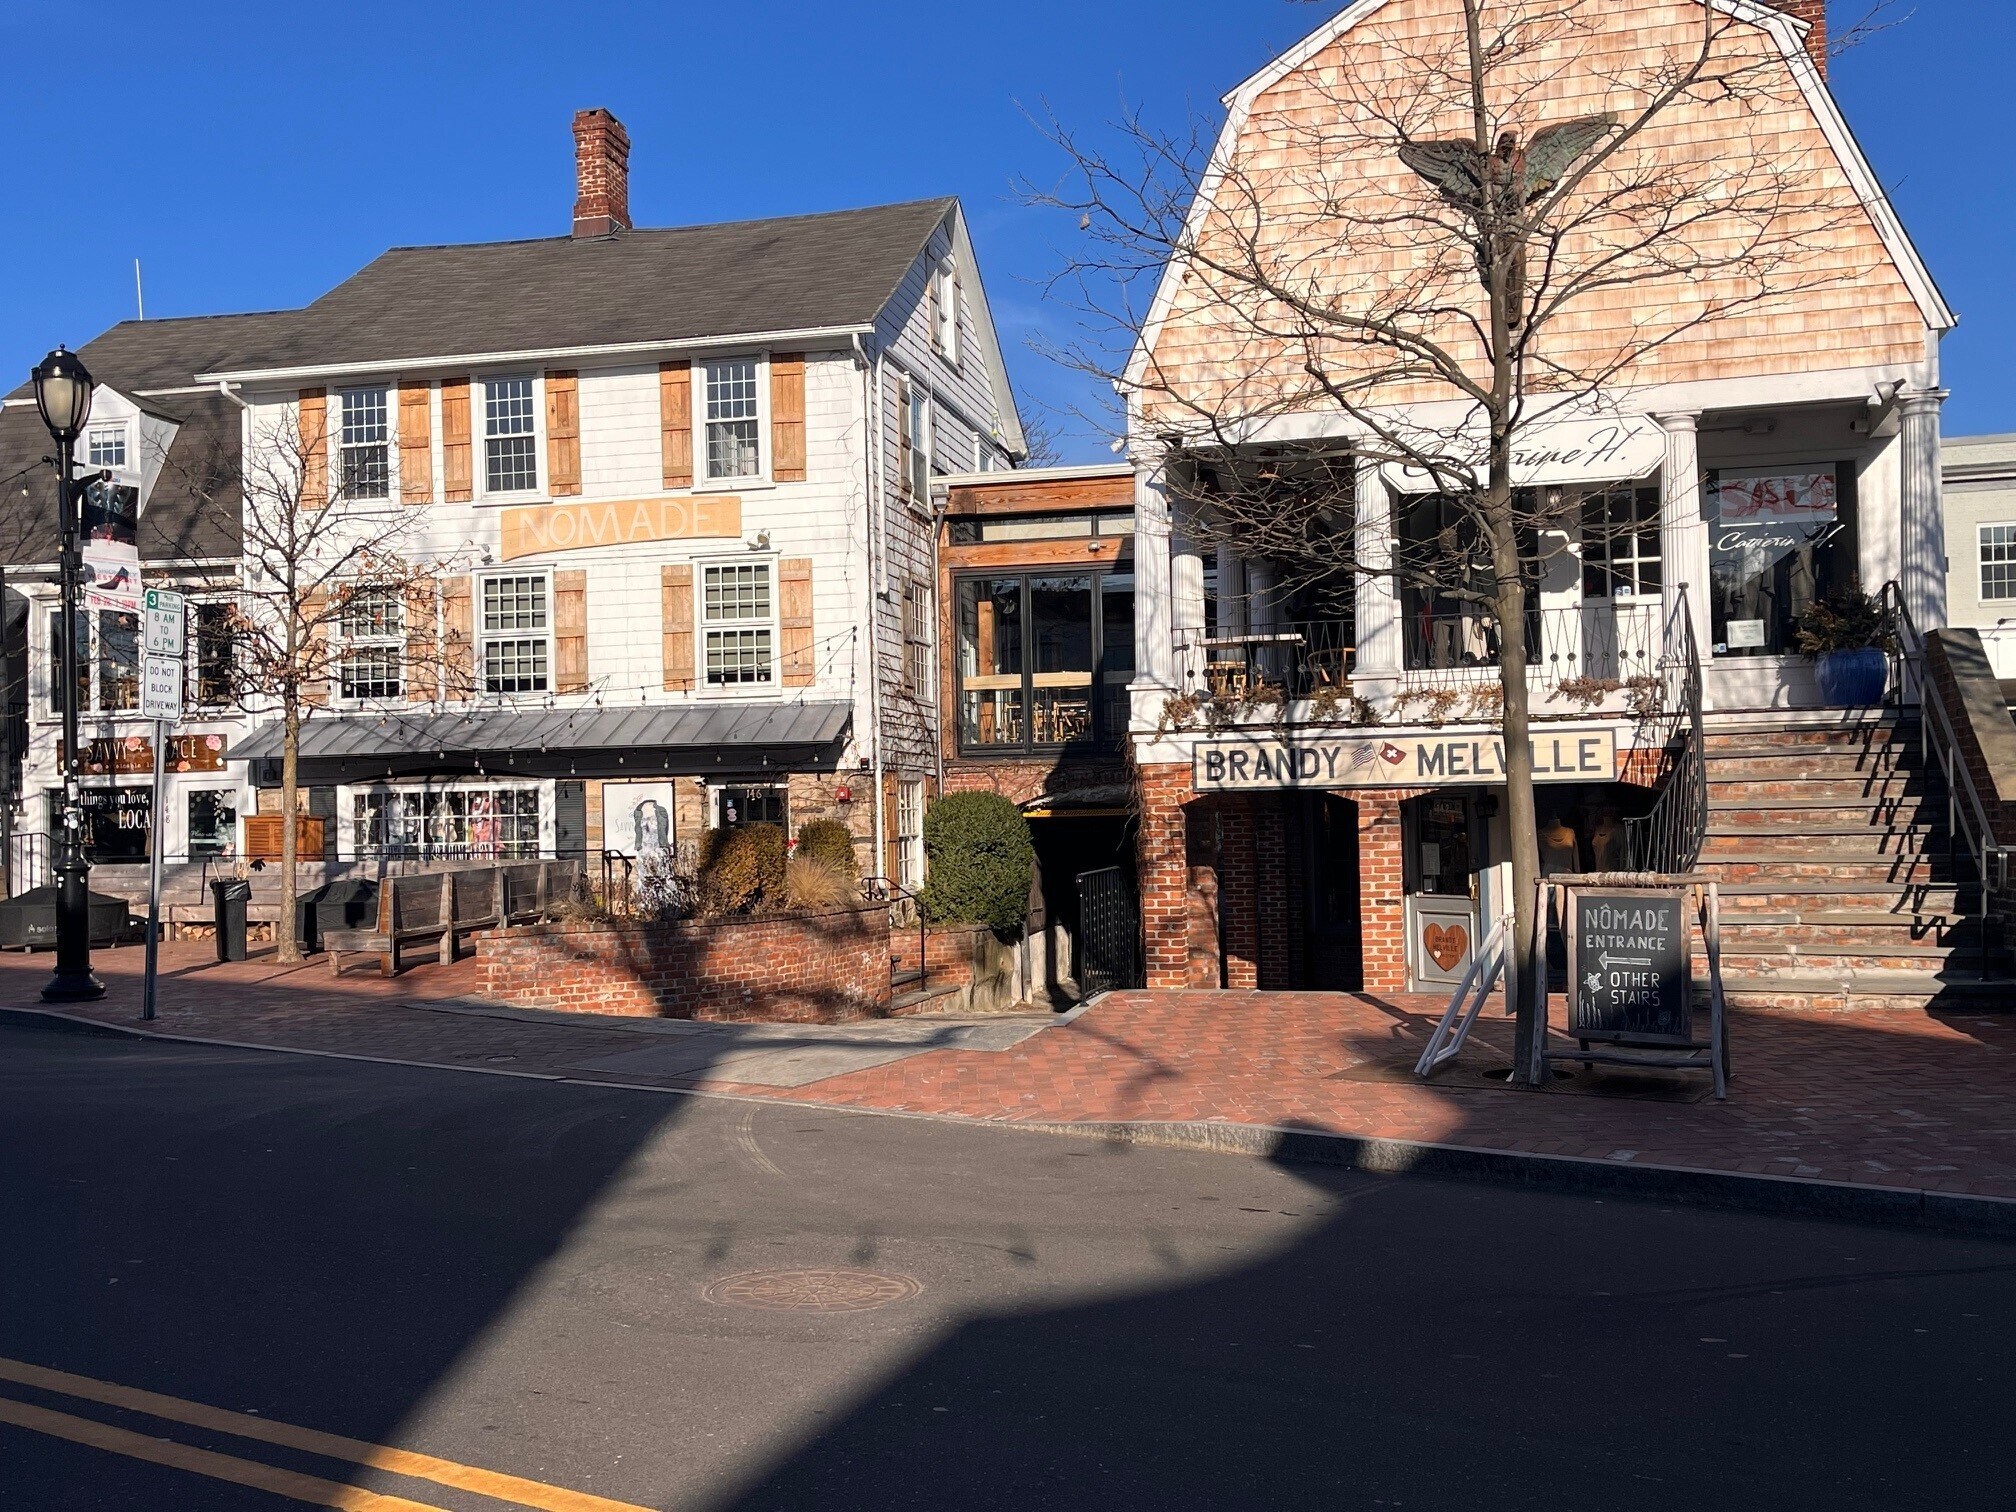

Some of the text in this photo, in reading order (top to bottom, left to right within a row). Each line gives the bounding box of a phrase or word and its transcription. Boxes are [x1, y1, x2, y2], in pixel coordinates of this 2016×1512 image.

[149, 593, 157, 606] 3
[159, 602, 181, 610] PARKING
[154, 612, 175, 624] 8 AM
[160, 625, 169, 635] TO
[153, 637, 174, 648] 6 PM
[150, 666, 175, 677] DO NOT
[151, 683, 173, 694] BLOCK
[145, 699, 178, 710] DRIVEWAY
[1206, 739, 1602, 782] BRANDY MELVLLE
[80, 790, 107, 810] things
[109, 794, 126, 810] you
[746, 789, 763, 799] 146
[118, 809, 152, 829] LOCA
[1585, 903, 1670, 931] NÔMADE
[1585, 935, 1666, 951] ENTRANCE
[1610, 971, 1660, 988] OTHER
[1610, 989, 1661, 1007] STAIRS
